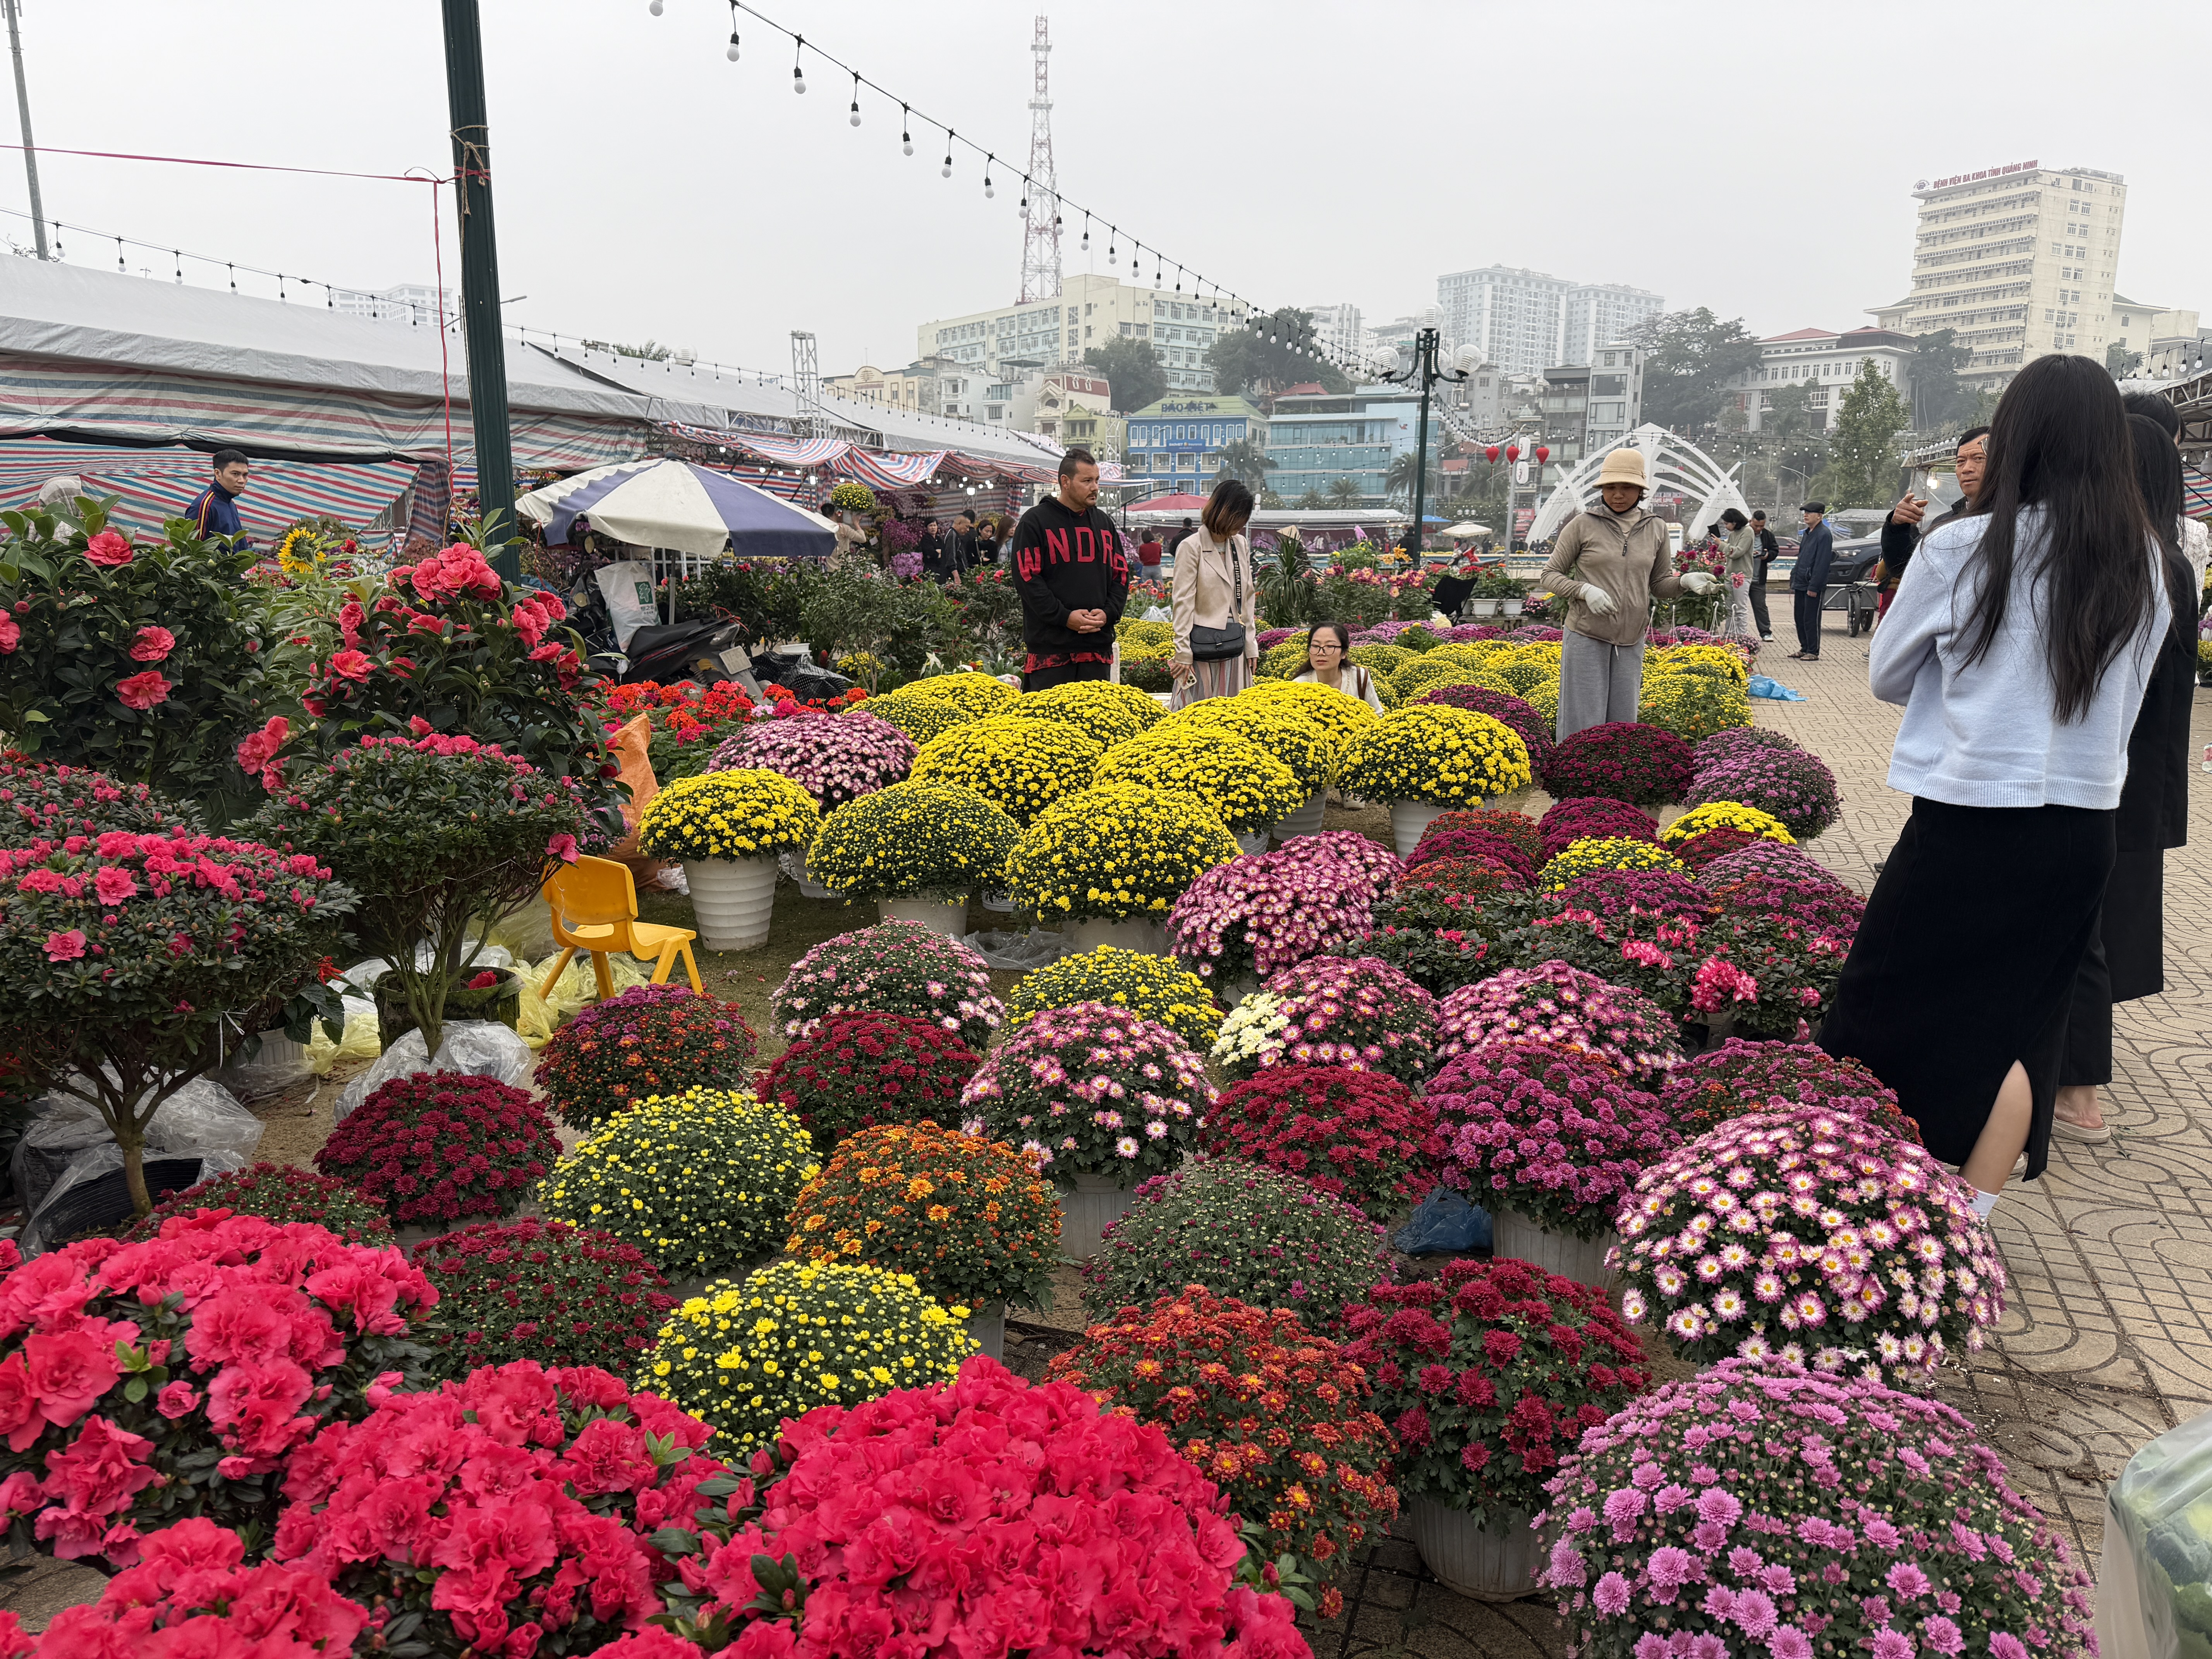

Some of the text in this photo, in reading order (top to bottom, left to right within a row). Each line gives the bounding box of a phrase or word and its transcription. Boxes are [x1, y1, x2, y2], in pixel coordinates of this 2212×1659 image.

[1934, 179, 1948, 189] BỆNH
[1949, 175, 1961, 185] VIỆN
[1972, 170, 1987, 180] KHOA
[1988, 166, 2001, 177] TỈNH
[2002, 162, 2021, 175] QUẢNG
[1162, 400, 1183, 412] BẢO
